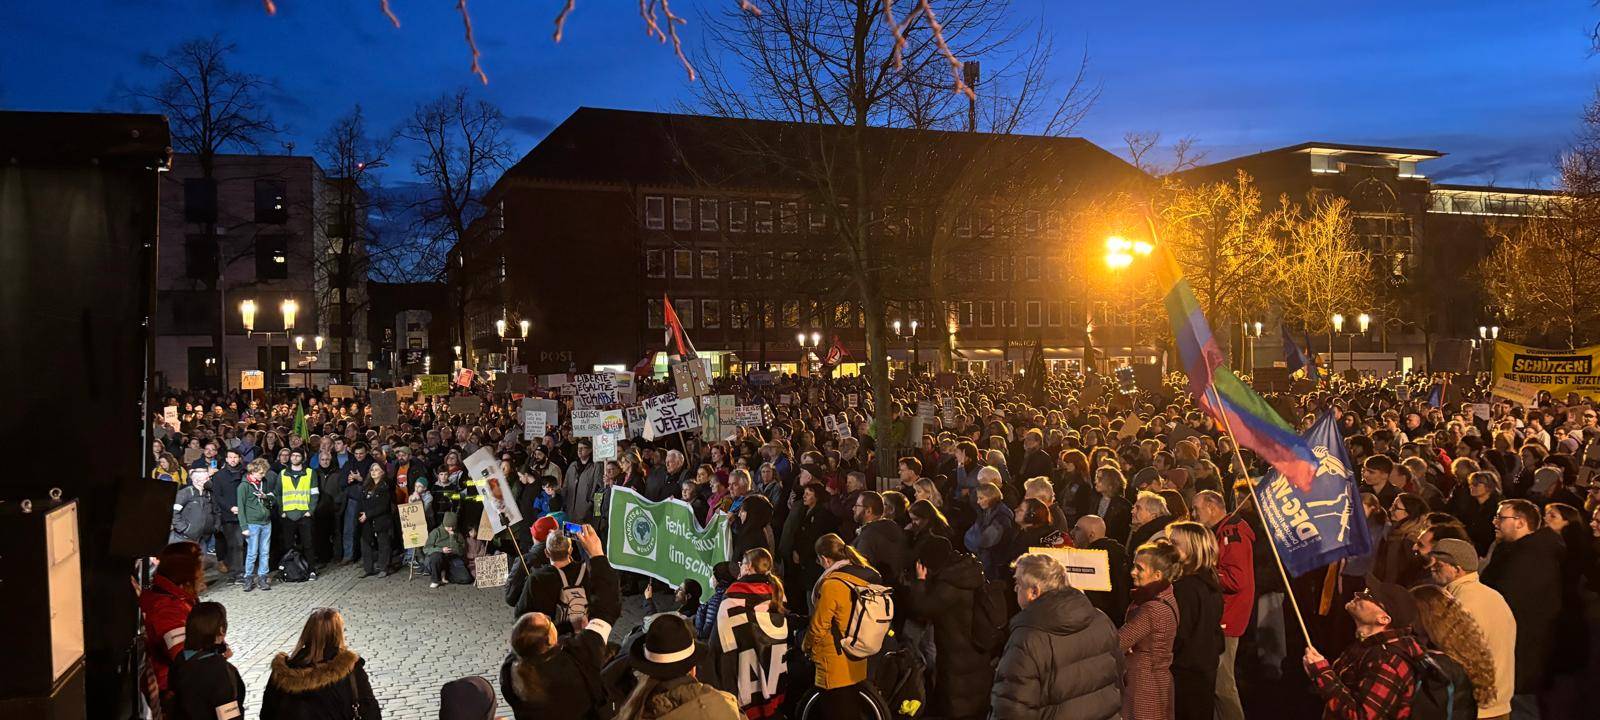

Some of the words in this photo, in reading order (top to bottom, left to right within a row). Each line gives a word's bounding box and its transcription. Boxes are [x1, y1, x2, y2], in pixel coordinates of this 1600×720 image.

[1515, 357, 1589, 373] SCHÜTZEN!
[1519, 374, 1552, 384] WIEDER
[1555, 375, 1569, 384] IST
